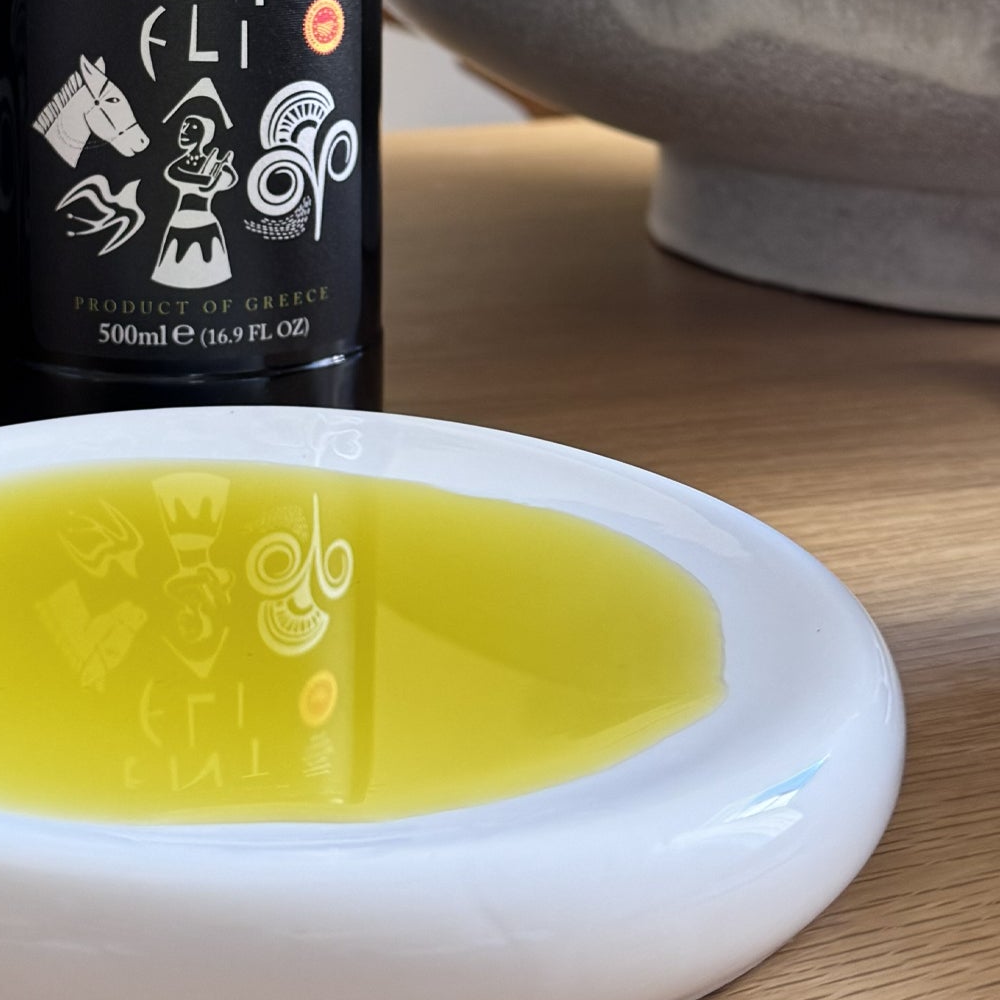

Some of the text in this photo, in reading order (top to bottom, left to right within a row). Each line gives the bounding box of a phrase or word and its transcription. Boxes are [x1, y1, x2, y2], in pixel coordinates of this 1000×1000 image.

[75, 286, 329, 315] PRODUCT OF GREECE
[200, 327, 244, 348] (16.9
[248, 323, 273, 342] FL
[277, 317, 310, 338] OZ)
